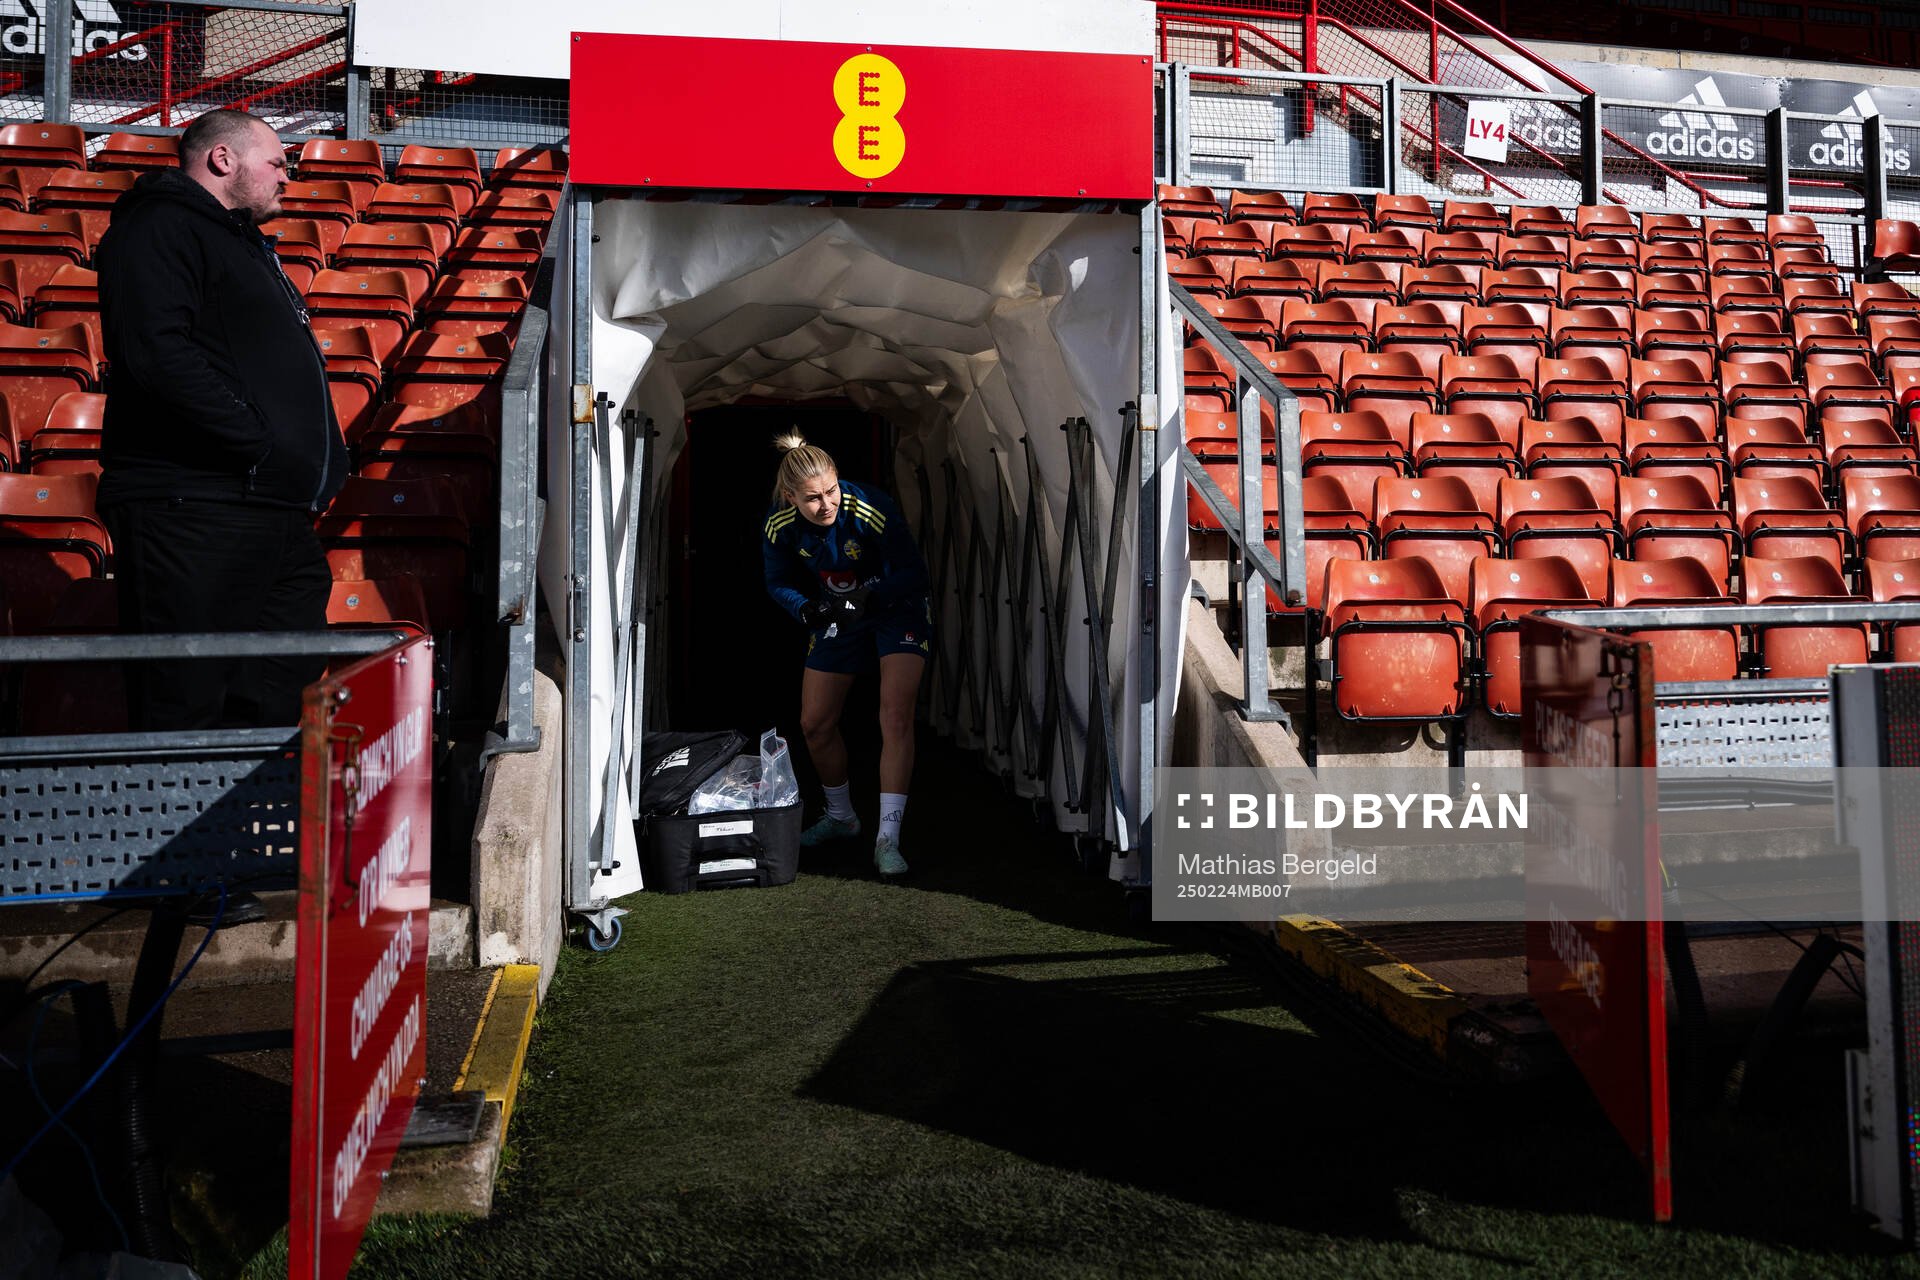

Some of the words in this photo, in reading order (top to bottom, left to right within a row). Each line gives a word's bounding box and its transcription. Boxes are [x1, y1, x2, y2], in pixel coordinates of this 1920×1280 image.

[0, 16, 149, 61] dias
[1469, 117, 1506, 143] LY4
[1645, 126, 1756, 161] adidas
[346, 728, 392, 814] DWCH
[1535, 699, 1575, 768] PLEASE
[1575, 719, 1609, 789] KEEP
[351, 928, 401, 1061] CHWARAE
[400, 911, 414, 972] OS
[1548, 901, 1603, 1011] SURFACE
[332, 1050, 390, 1220] GWELWCH
[389, 1024, 404, 1094] YN
[402, 993, 420, 1068] DDA
